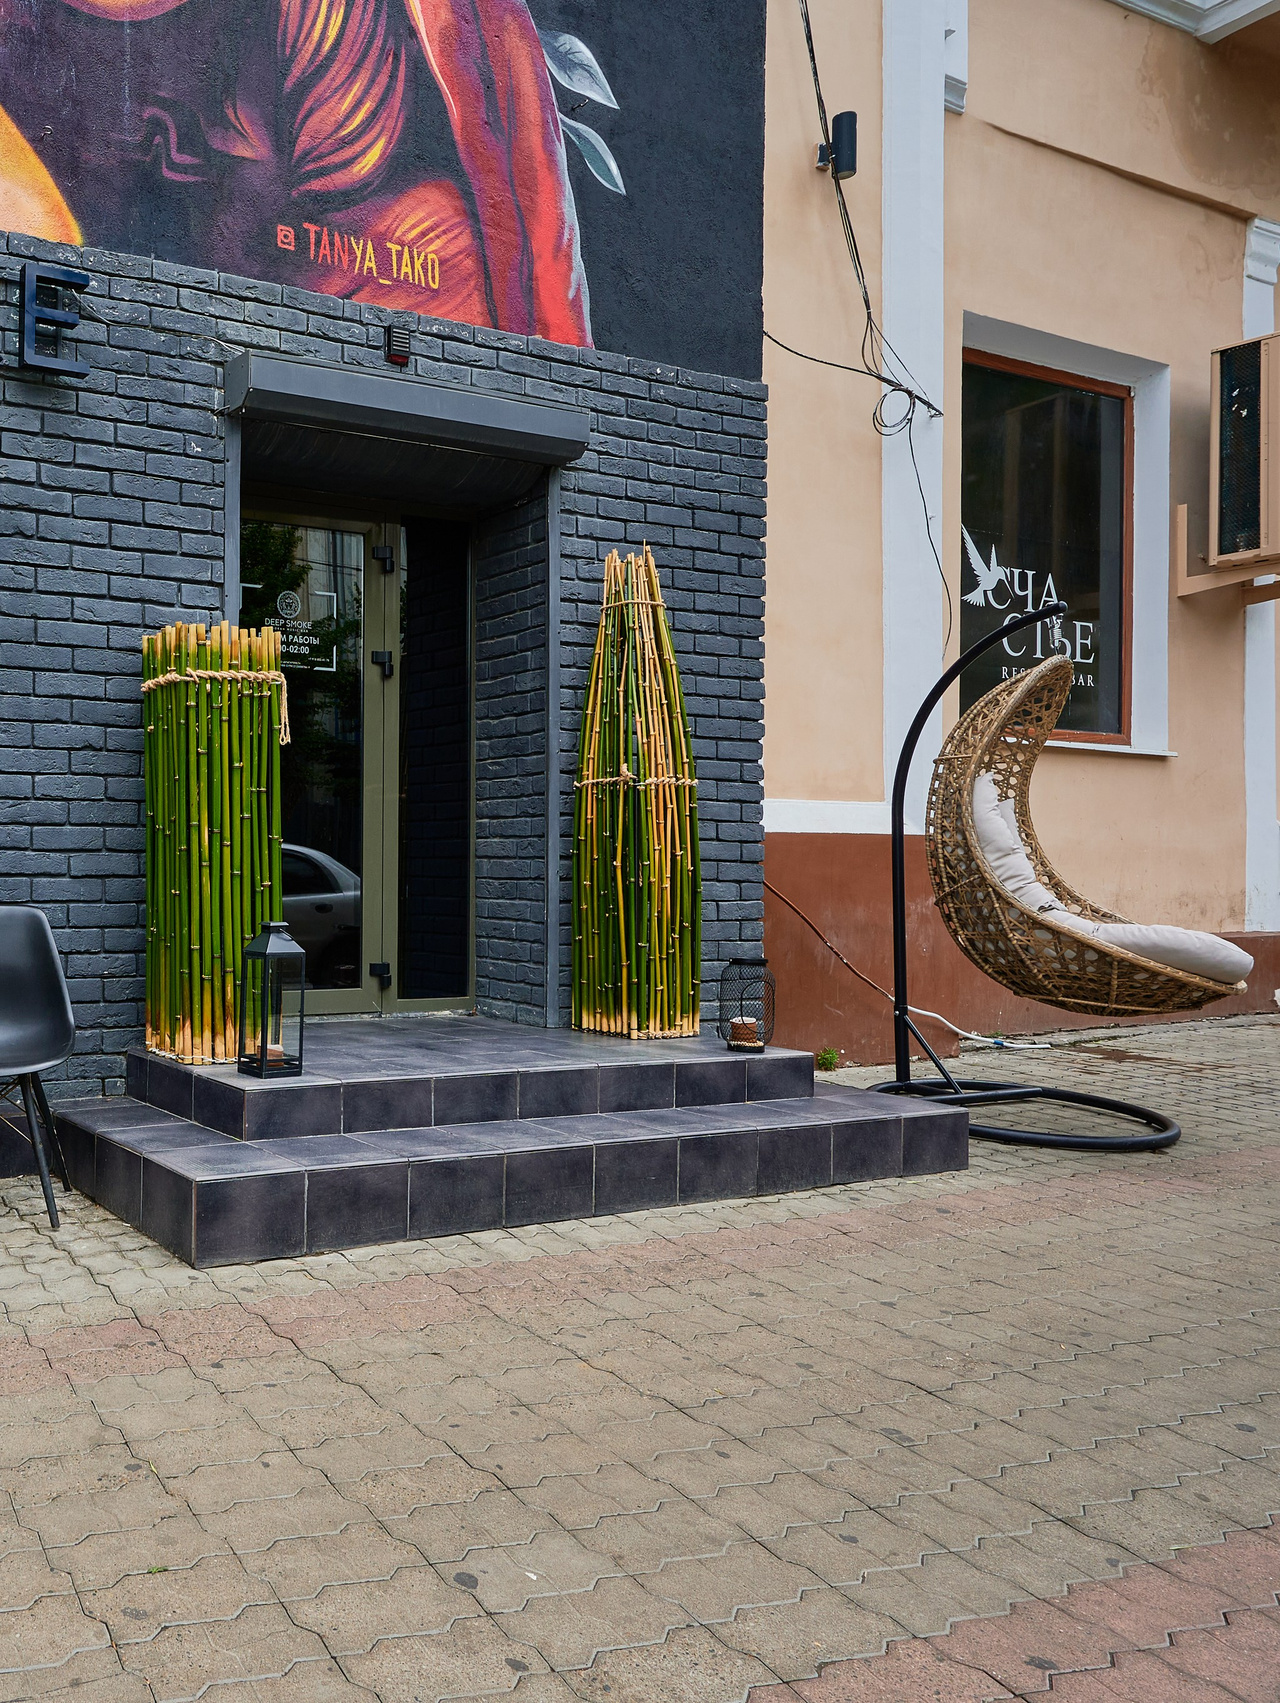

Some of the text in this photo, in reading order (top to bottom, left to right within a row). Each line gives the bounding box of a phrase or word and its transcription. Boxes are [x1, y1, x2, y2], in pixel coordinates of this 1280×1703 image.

[303, 222, 440, 289] TANYA_TAKO
[265, 618, 284, 626] DEEP
[286, 620, 312, 629] SMOKE
[289, 634, 320, 644] РАБОТЫ
